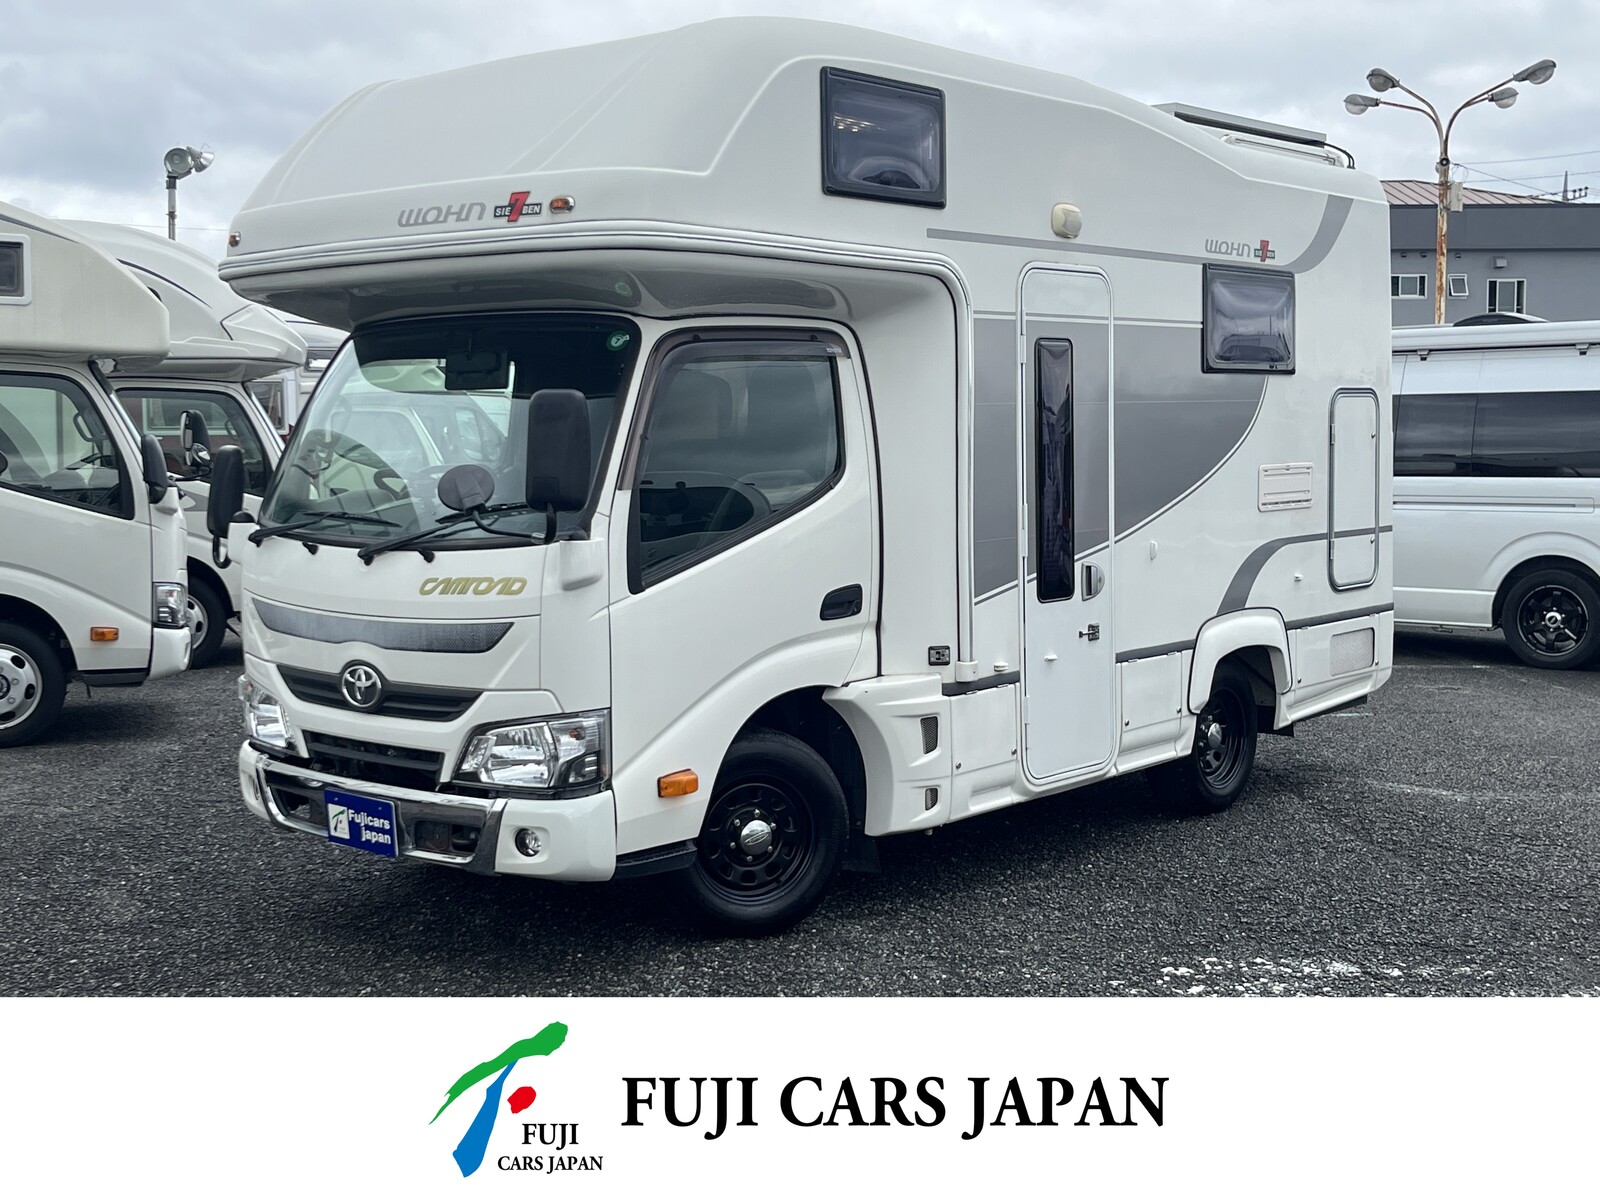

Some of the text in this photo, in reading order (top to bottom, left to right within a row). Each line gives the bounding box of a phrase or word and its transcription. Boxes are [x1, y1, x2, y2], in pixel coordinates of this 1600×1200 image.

[419, 577, 527, 595] CAMROAD
[348, 809, 390, 829] Fujicars
[361, 827, 391, 844] japan
